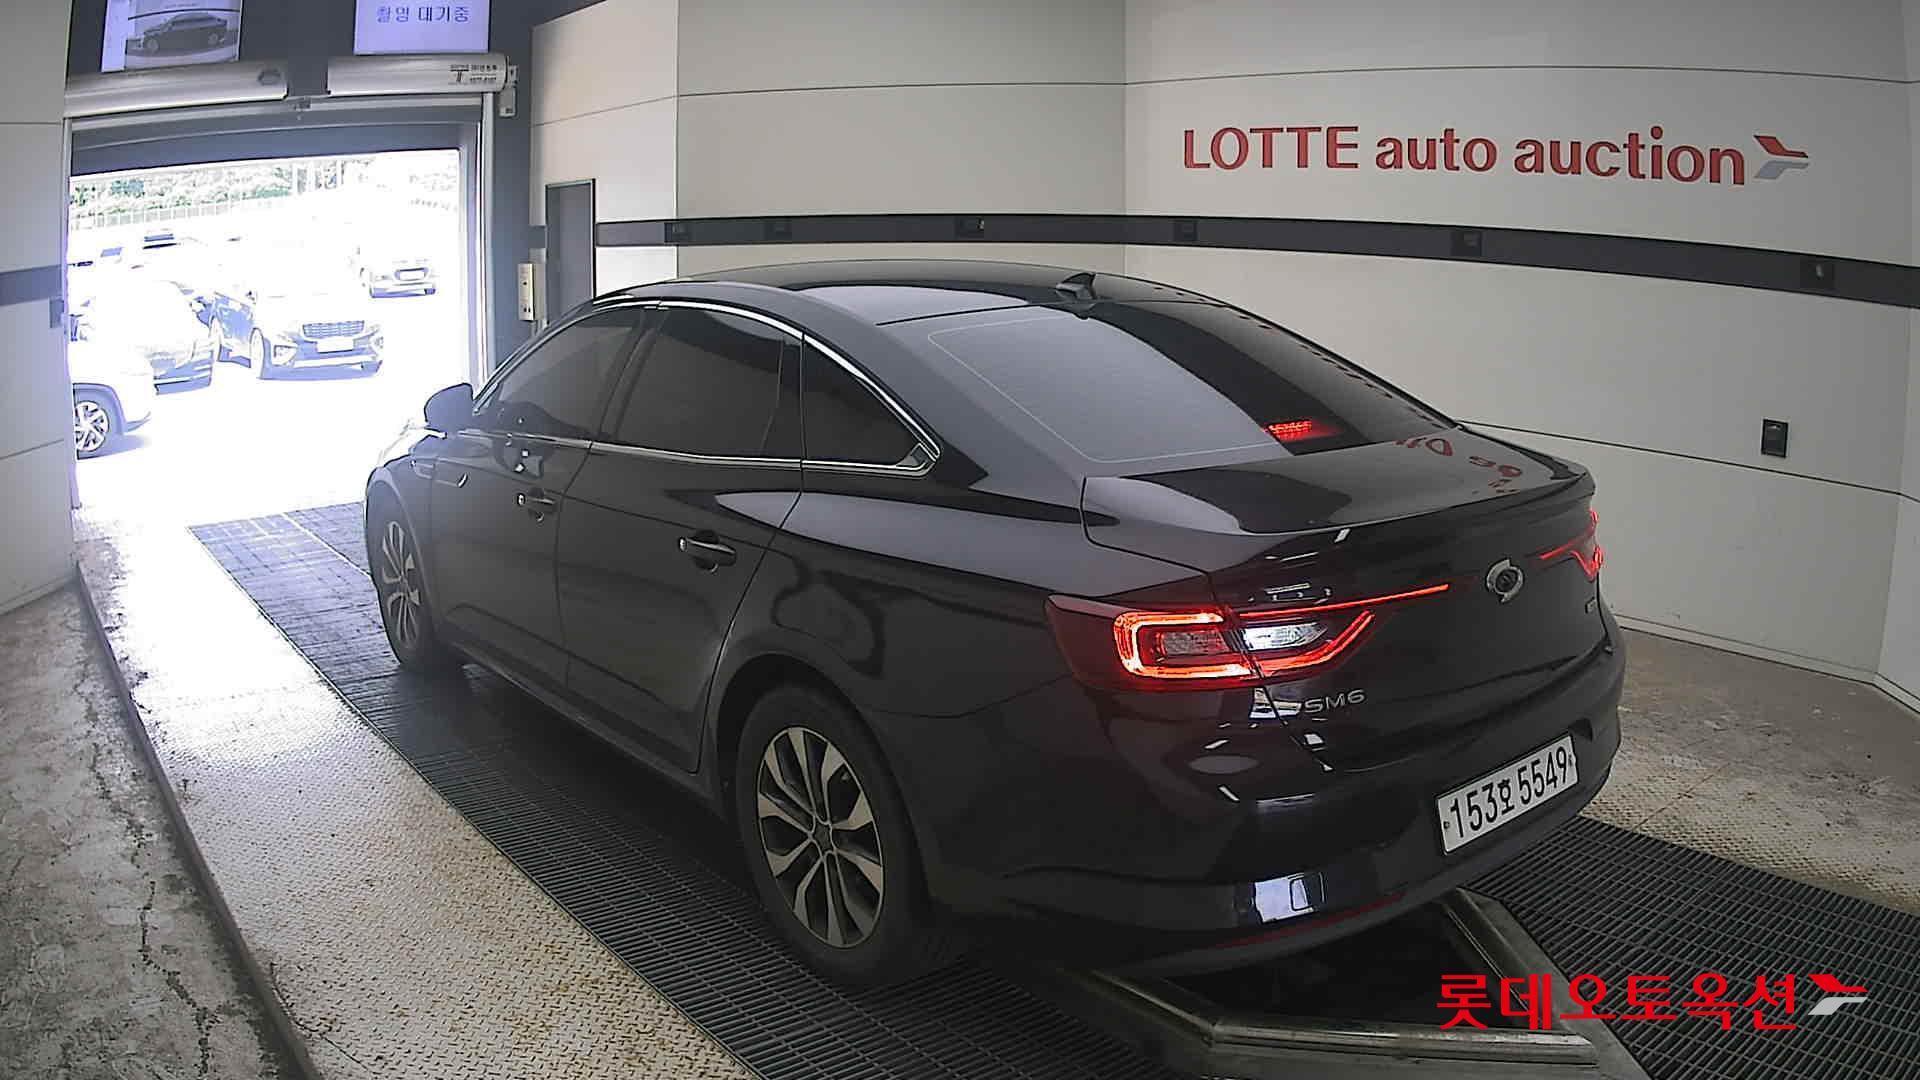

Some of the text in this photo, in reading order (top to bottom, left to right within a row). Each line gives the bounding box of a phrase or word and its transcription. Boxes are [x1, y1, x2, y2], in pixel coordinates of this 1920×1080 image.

[417, 5, 469, 23] 대기중
[1184, 125, 1745, 186] LOTTE auto auction
[1304, 689, 1366, 714] SM6
[1450, 746, 1568, 838] 153호 5549
